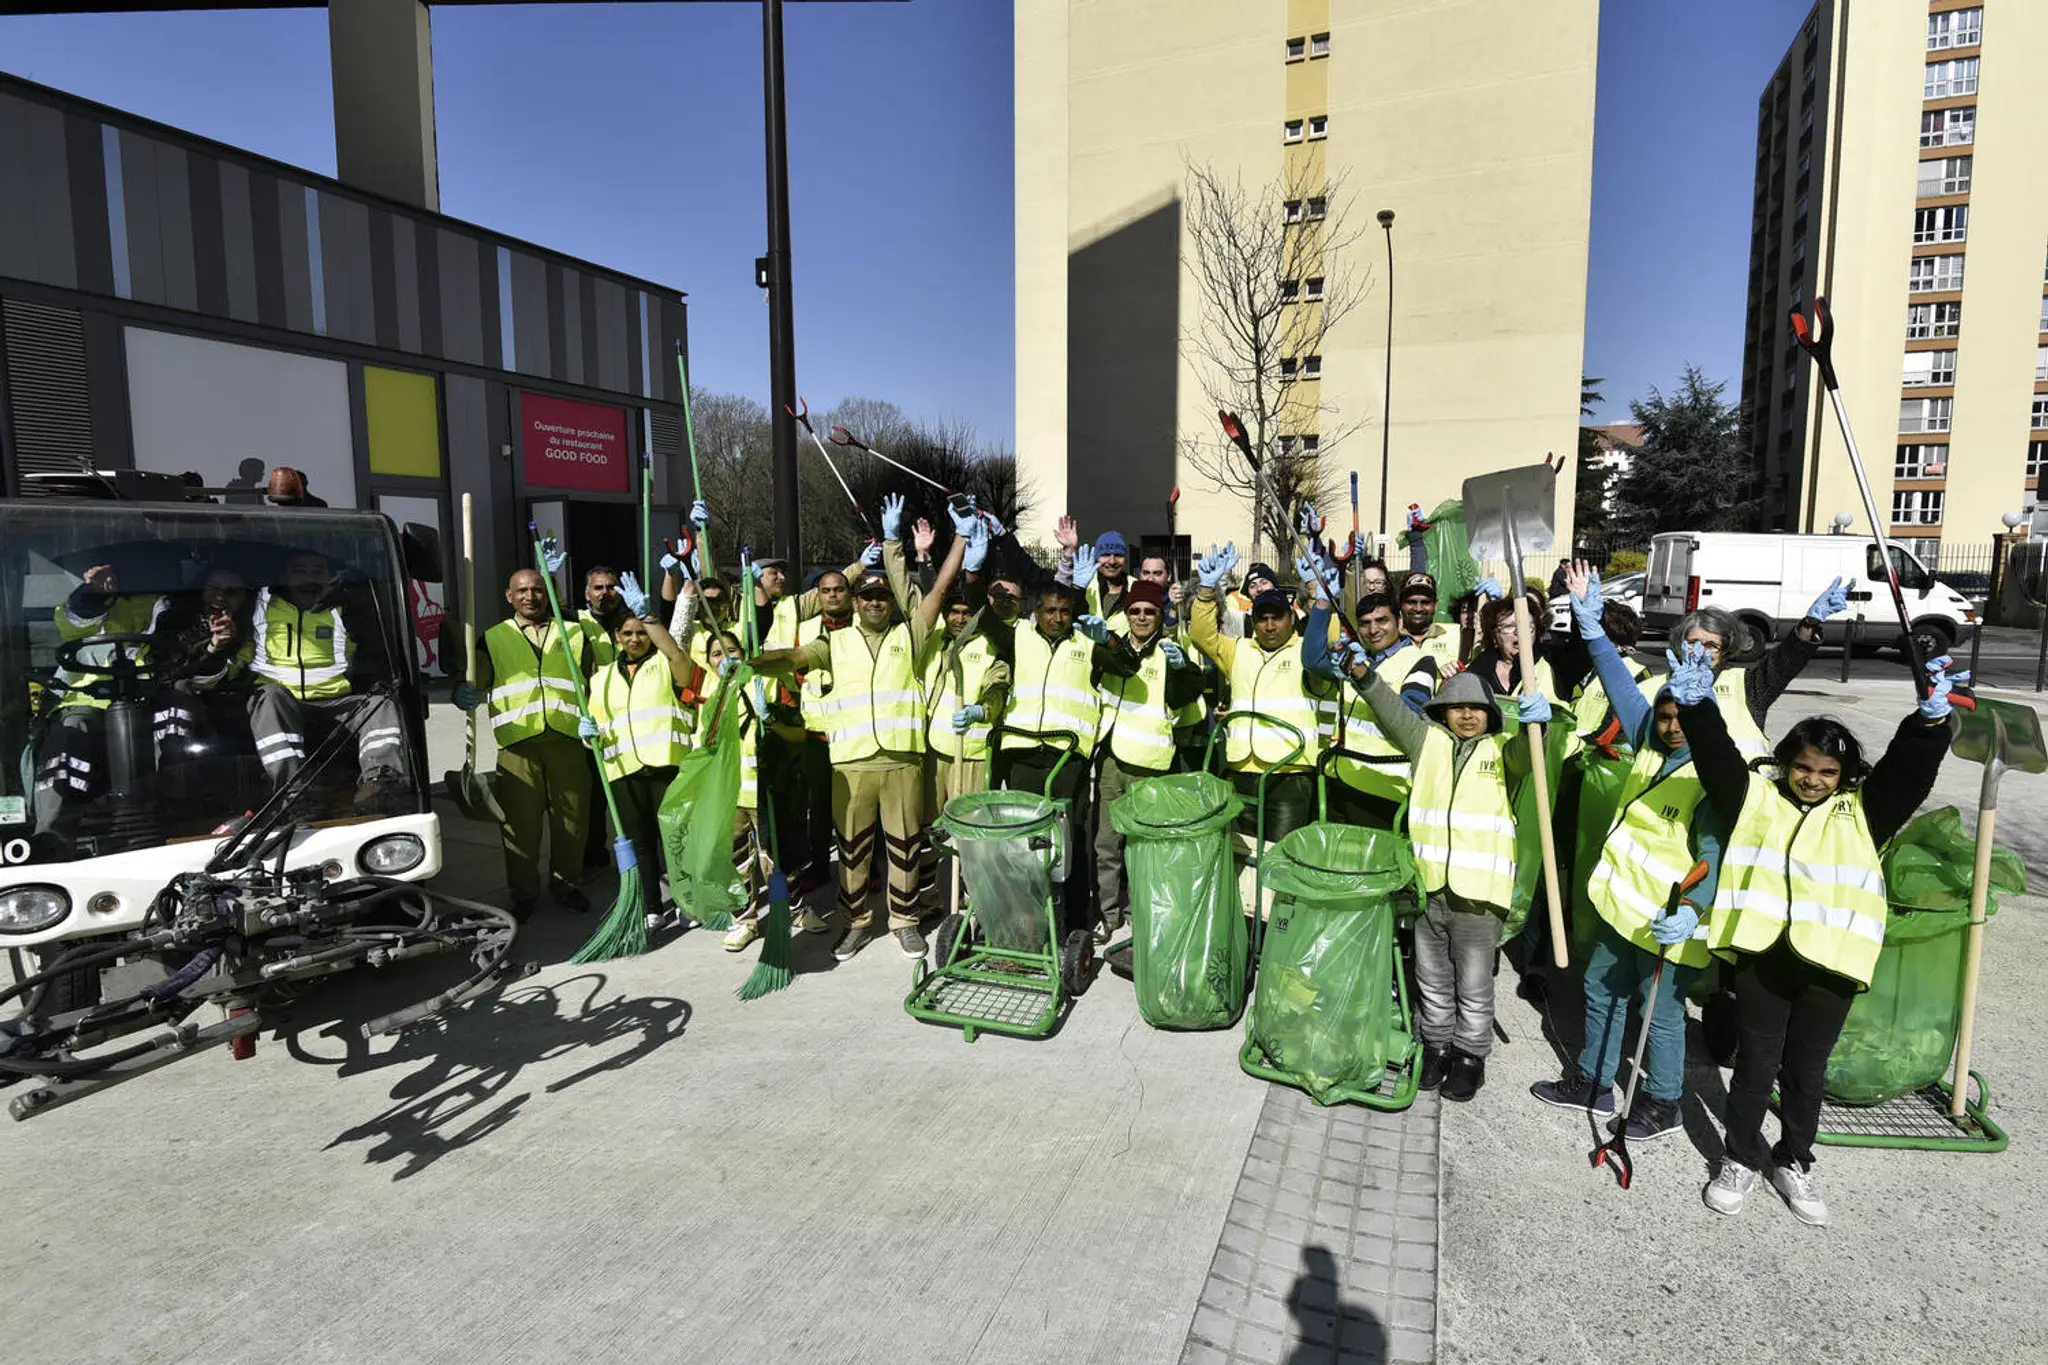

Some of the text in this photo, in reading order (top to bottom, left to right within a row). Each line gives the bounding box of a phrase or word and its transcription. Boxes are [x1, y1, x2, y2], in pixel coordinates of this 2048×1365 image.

[534, 420, 615, 441] Ouverture prochaine
[549, 435, 602, 450] du restaurant
[545, 448, 608, 464] GOOD FOOD
[1479, 760, 1496, 771] IVR
[0, 838, 31, 864] O
